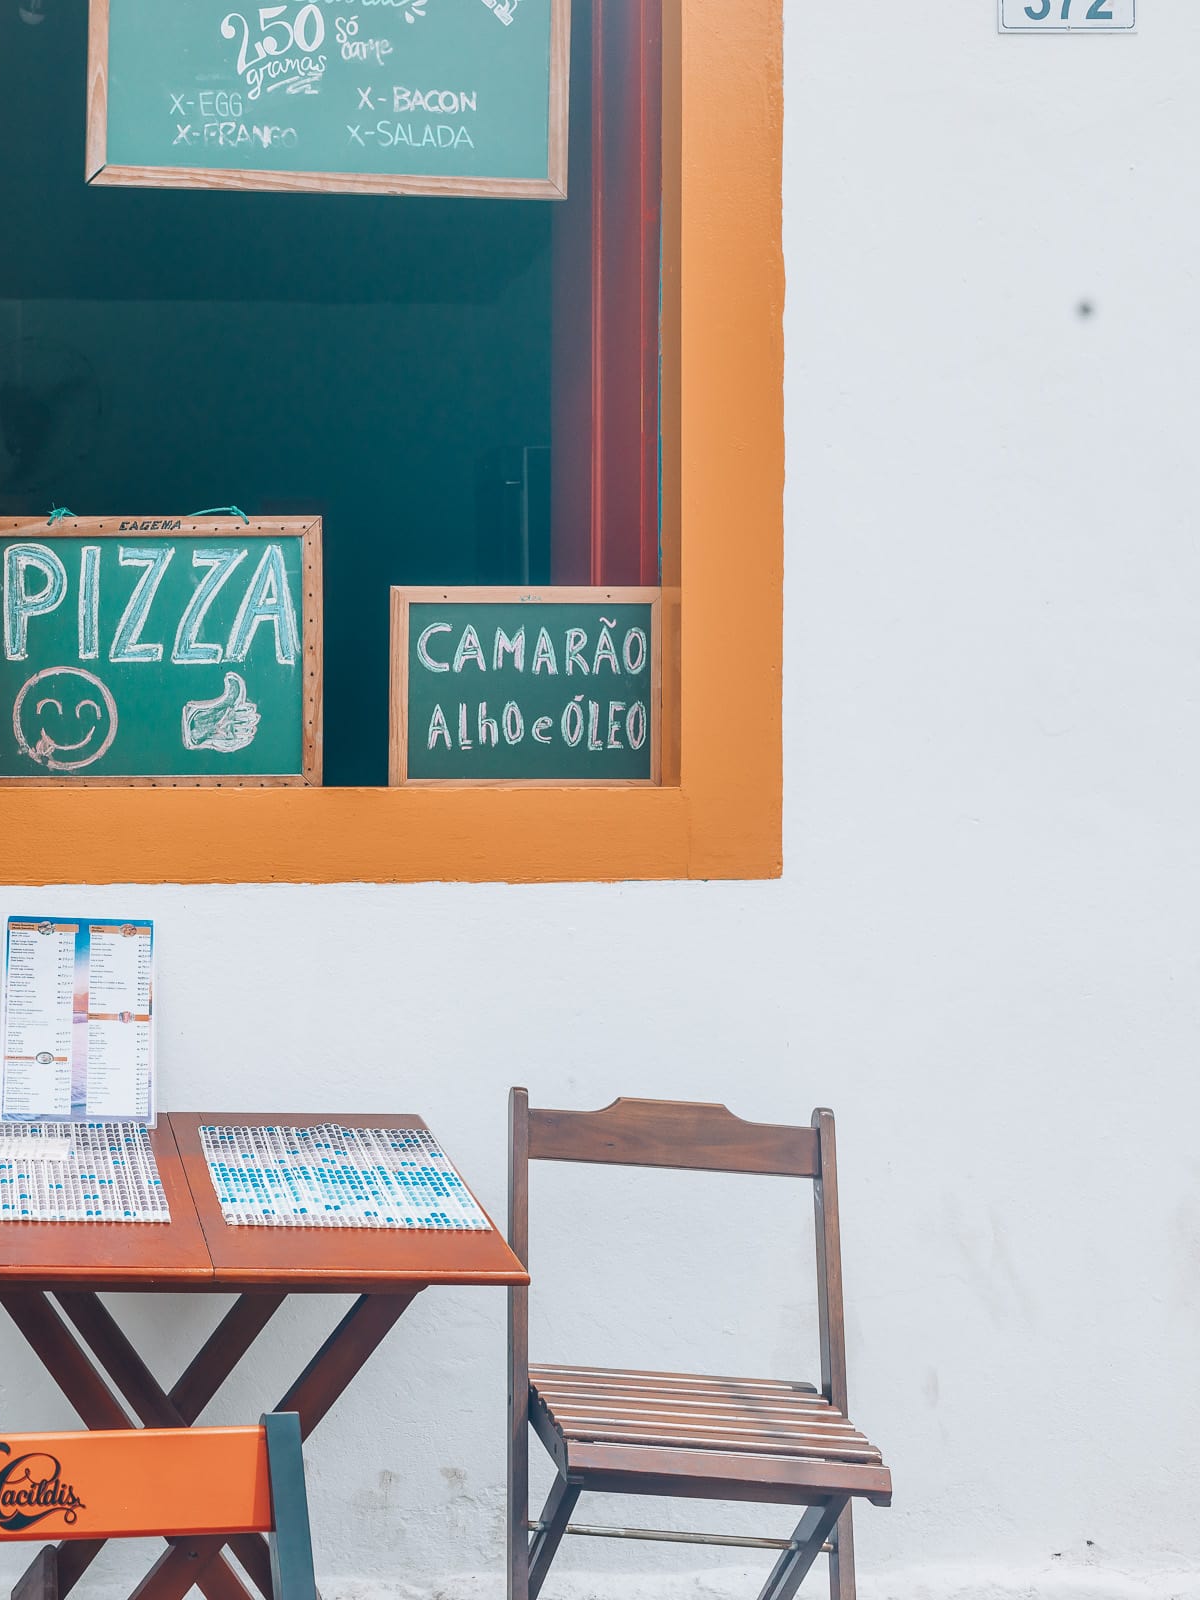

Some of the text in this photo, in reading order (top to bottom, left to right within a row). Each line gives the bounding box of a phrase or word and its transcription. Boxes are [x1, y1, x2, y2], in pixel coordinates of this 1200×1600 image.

[220, 4, 325, 74] 250
[246, 55, 327, 100] gramas
[3, 543, 301, 665] PIZZA
[416, 617, 647, 675] CAMARÃO
[531, 716, 553, 744] e
[560, 694, 647, 750] ÓLEO
